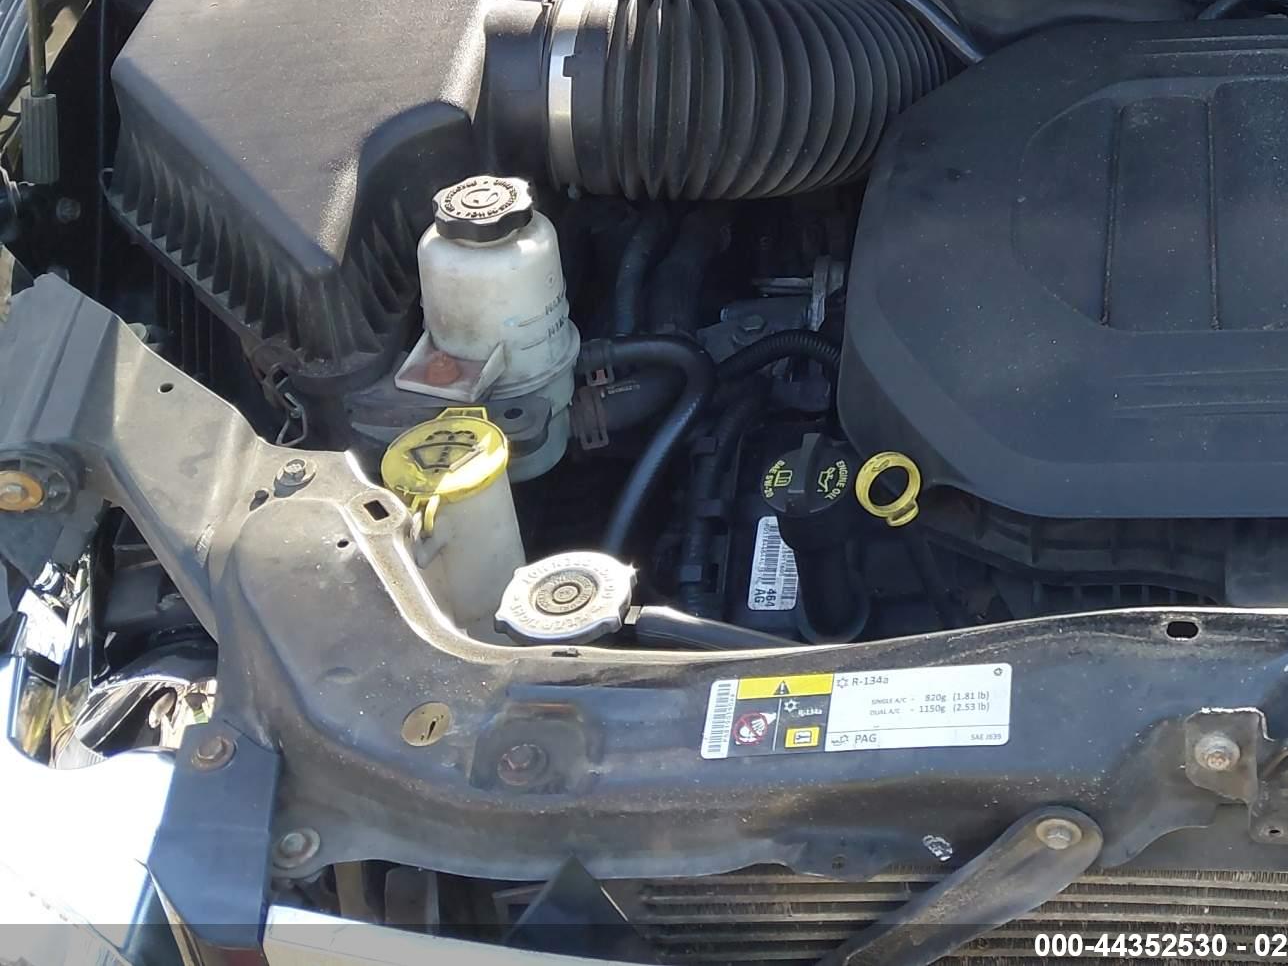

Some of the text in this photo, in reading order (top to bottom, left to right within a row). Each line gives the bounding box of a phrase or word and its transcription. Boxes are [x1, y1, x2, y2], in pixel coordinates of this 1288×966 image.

[763, 459, 785, 499] SAE 5W-20
[824, 459, 849, 501] ENGINE OIL
[754, 588, 765, 604] AG
[851, 675, 889, 686] R-134a
[924, 693, 947, 703] 820g
[952, 692, 975, 703] (1.81
[976, 690, 990, 702] lb)
[919, 704, 946, 714] 1150g
[952, 703, 975, 713] (2.53
[976, 702, 990, 713] lb)
[854, 734, 878, 744] PAG
